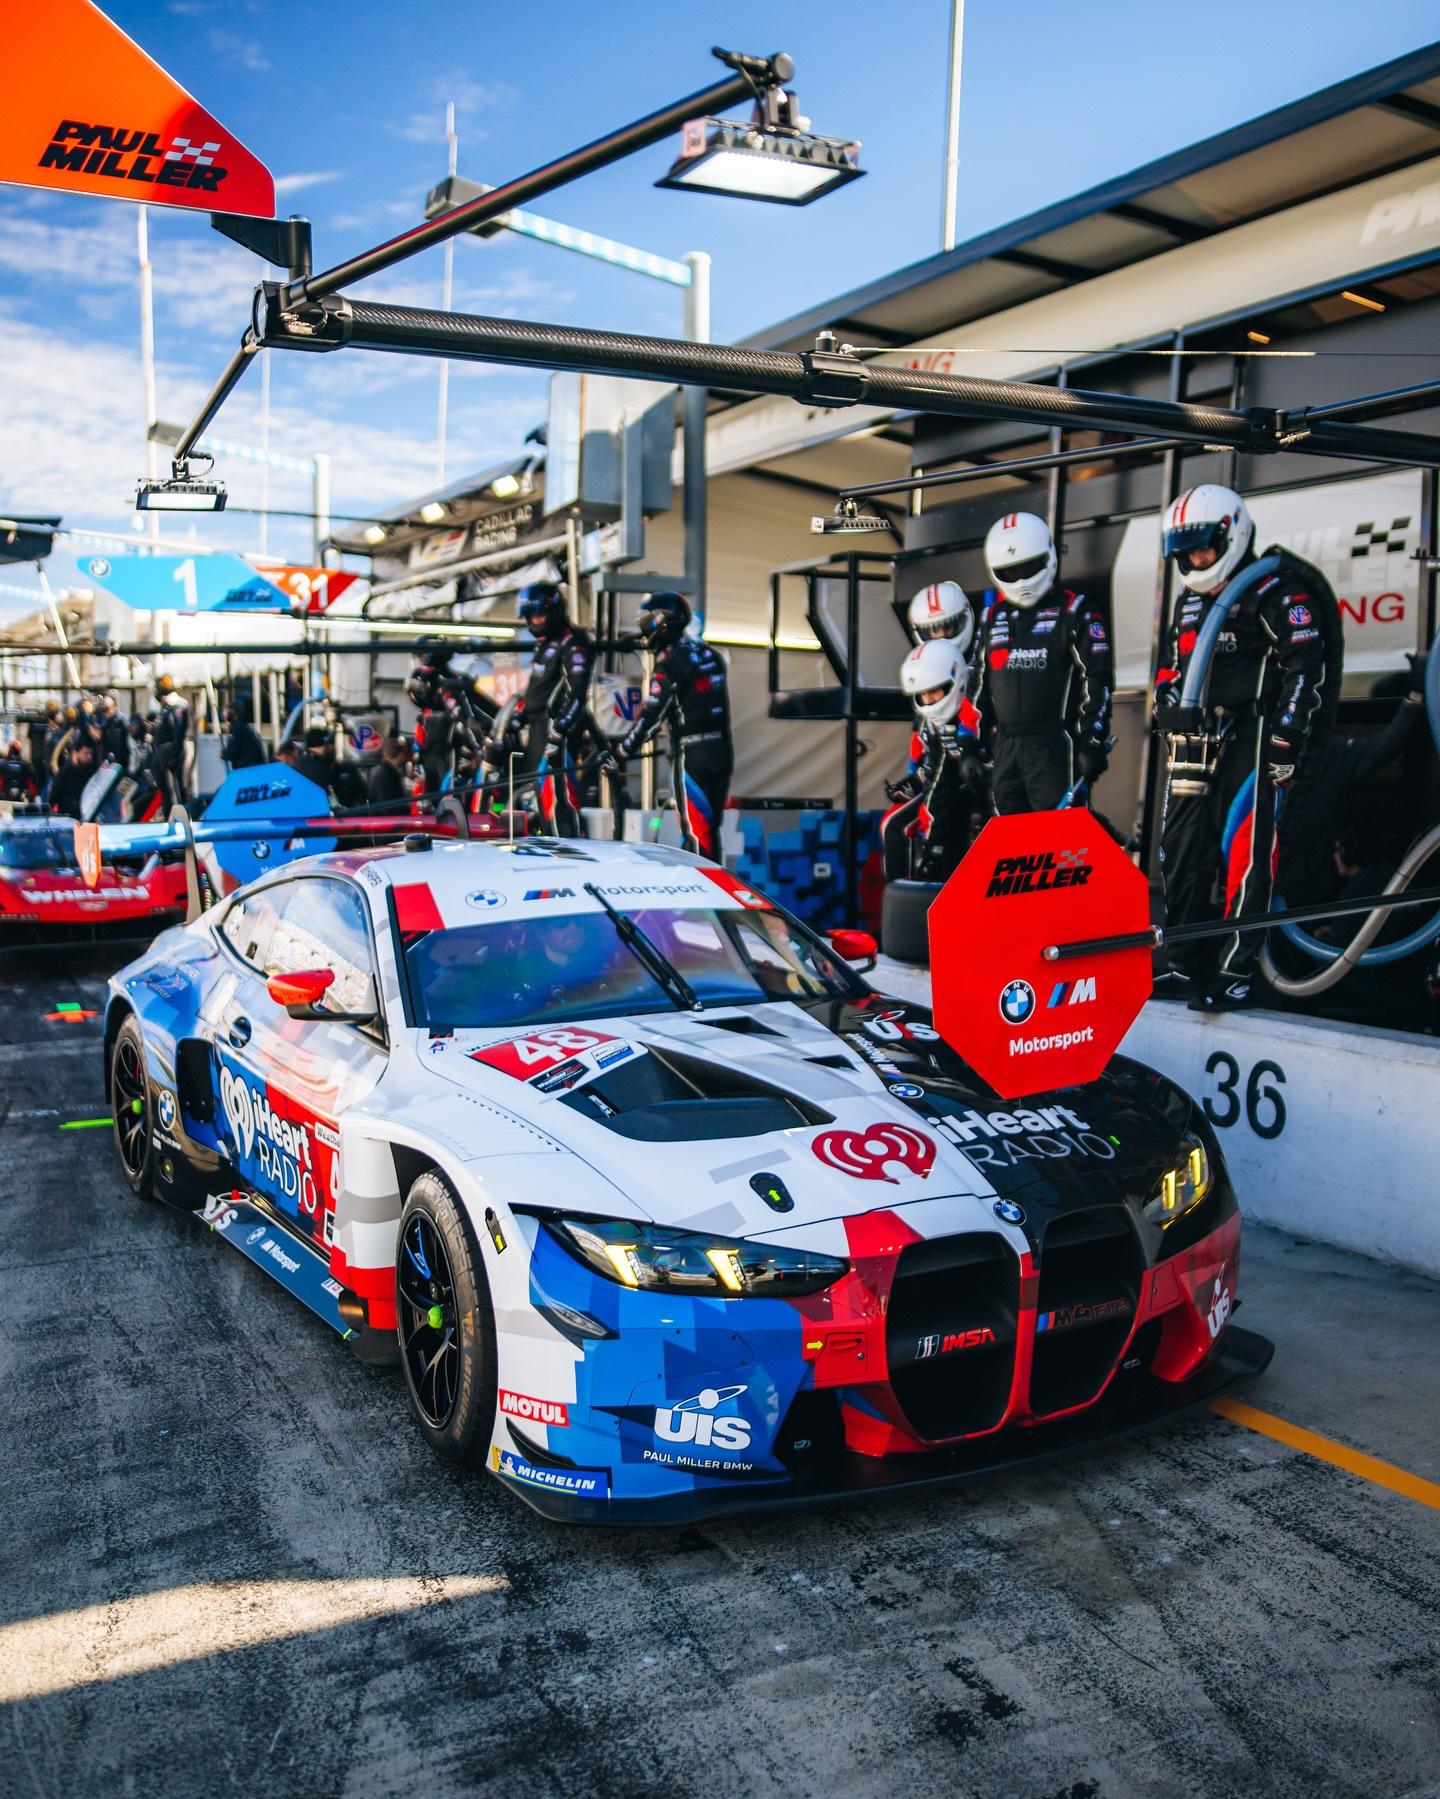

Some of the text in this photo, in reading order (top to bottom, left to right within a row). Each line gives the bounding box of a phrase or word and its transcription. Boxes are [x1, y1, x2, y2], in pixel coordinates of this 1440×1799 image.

[52, 120, 165, 156] PAUL
[38, 143, 229, 192] MILLER
[475, 504, 533, 536] CADILLAC
[173, 558, 198, 605] 1
[1007, 659, 1048, 670] RADIO
[235, 787, 292, 805] MILLER
[993, 853, 1058, 877] PAUL
[22, 886, 149, 903] WHELEN
[587, 883, 707, 898] Motorsport
[985, 865, 1093, 898] MILLER
[863, 1021, 940, 1040] UIS
[1009, 1026, 1094, 1056] Motorsport
[512, 1030, 600, 1066] 48
[1202, 1051, 1286, 1139] 36
[252, 1088, 312, 1170] iHeart
[927, 1105, 1091, 1144] iHeart
[959, 1132, 1115, 1174] RADIO
[258, 1136, 316, 1214] RADIO
[1208, 1288, 1230, 1338] UIS
[942, 1326, 996, 1352] IMSA
[503, 1393, 566, 1424] MOTUL
[654, 1408, 752, 1450] UIS
[643, 1450, 753, 1471] PAUL MILLER BMW
[517, 1465, 596, 1490] MICHELIN
